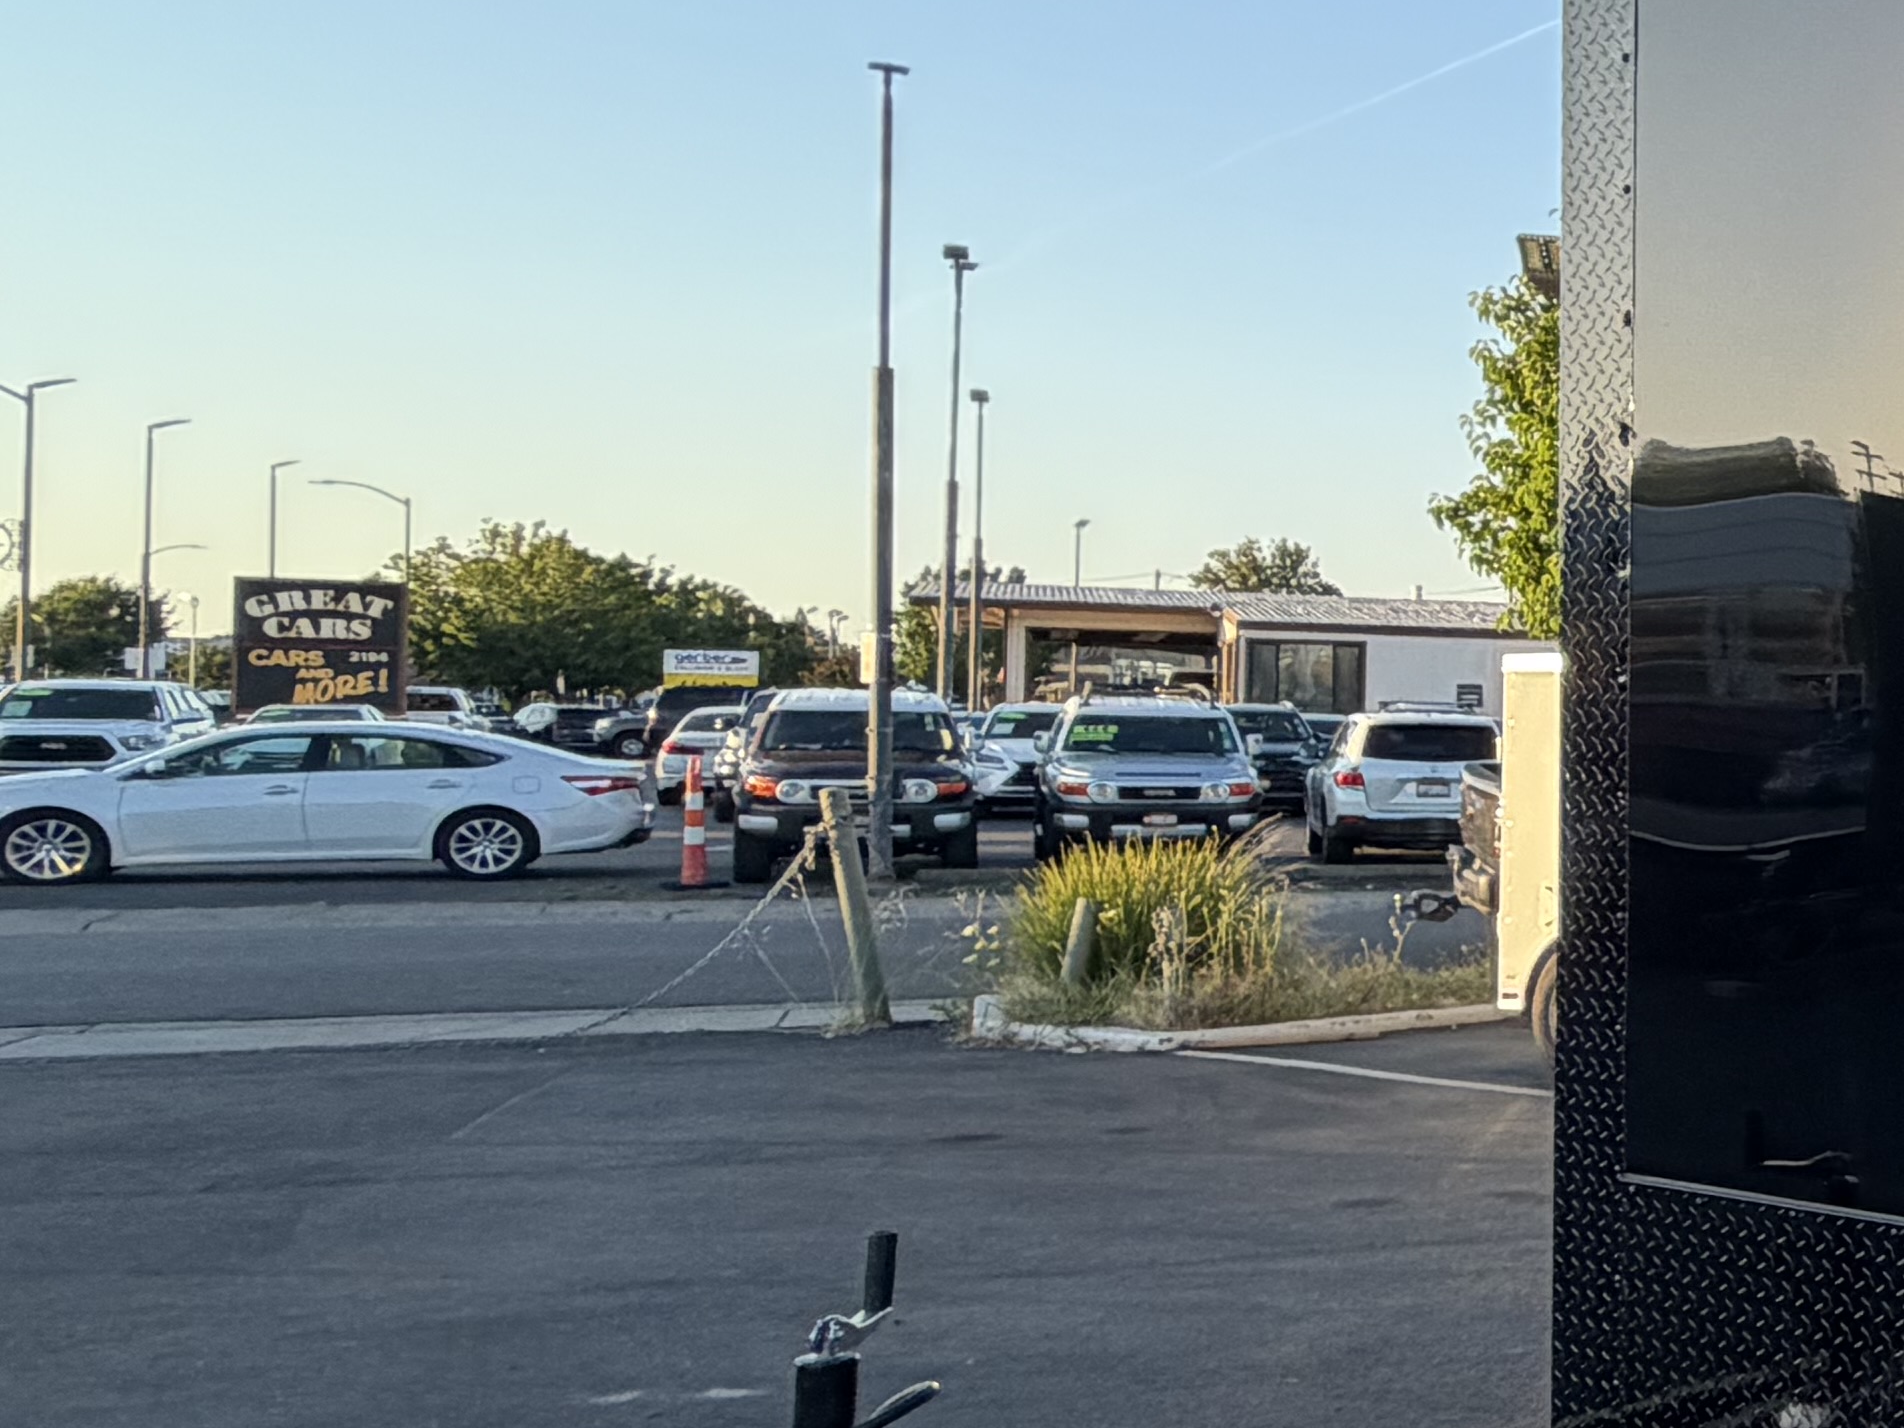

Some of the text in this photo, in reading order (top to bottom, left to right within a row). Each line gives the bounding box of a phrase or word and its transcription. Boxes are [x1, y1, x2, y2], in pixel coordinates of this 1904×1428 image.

[244, 589, 395, 619] GREAT
[262, 616, 372, 641] CARS
[248, 648, 325, 667] CARS
[292, 668, 389, 704] MORE!
[295, 668, 335, 679] AND
